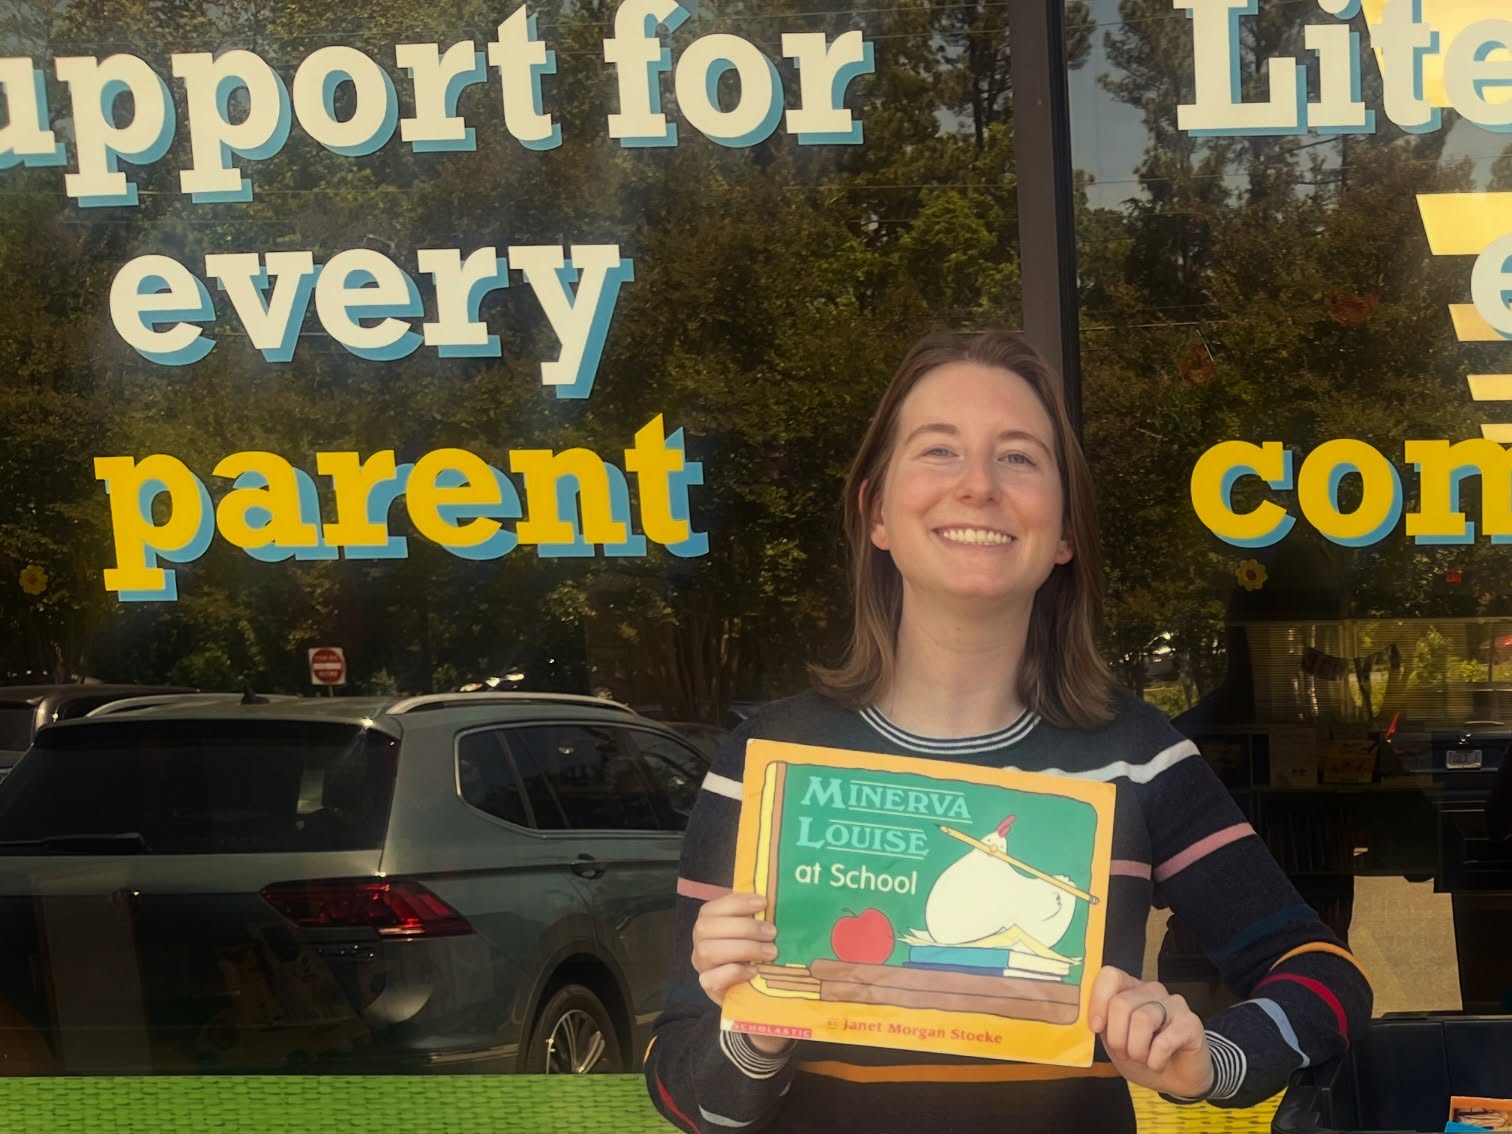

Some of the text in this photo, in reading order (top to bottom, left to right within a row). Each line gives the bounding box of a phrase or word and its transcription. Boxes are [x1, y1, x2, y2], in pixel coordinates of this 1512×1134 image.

[604, 0, 874, 146] for
[110, 244, 634, 399] every
[94, 413, 709, 601] parent
[801, 776, 972, 819] MINERVA
[796, 816, 929, 856] LOUISE
[795, 862, 918, 895] at School
[843, 1018, 882, 1033] Janet
[888, 1023, 945, 1040] Morgan
[950, 1028, 1003, 1044] Stoeke
